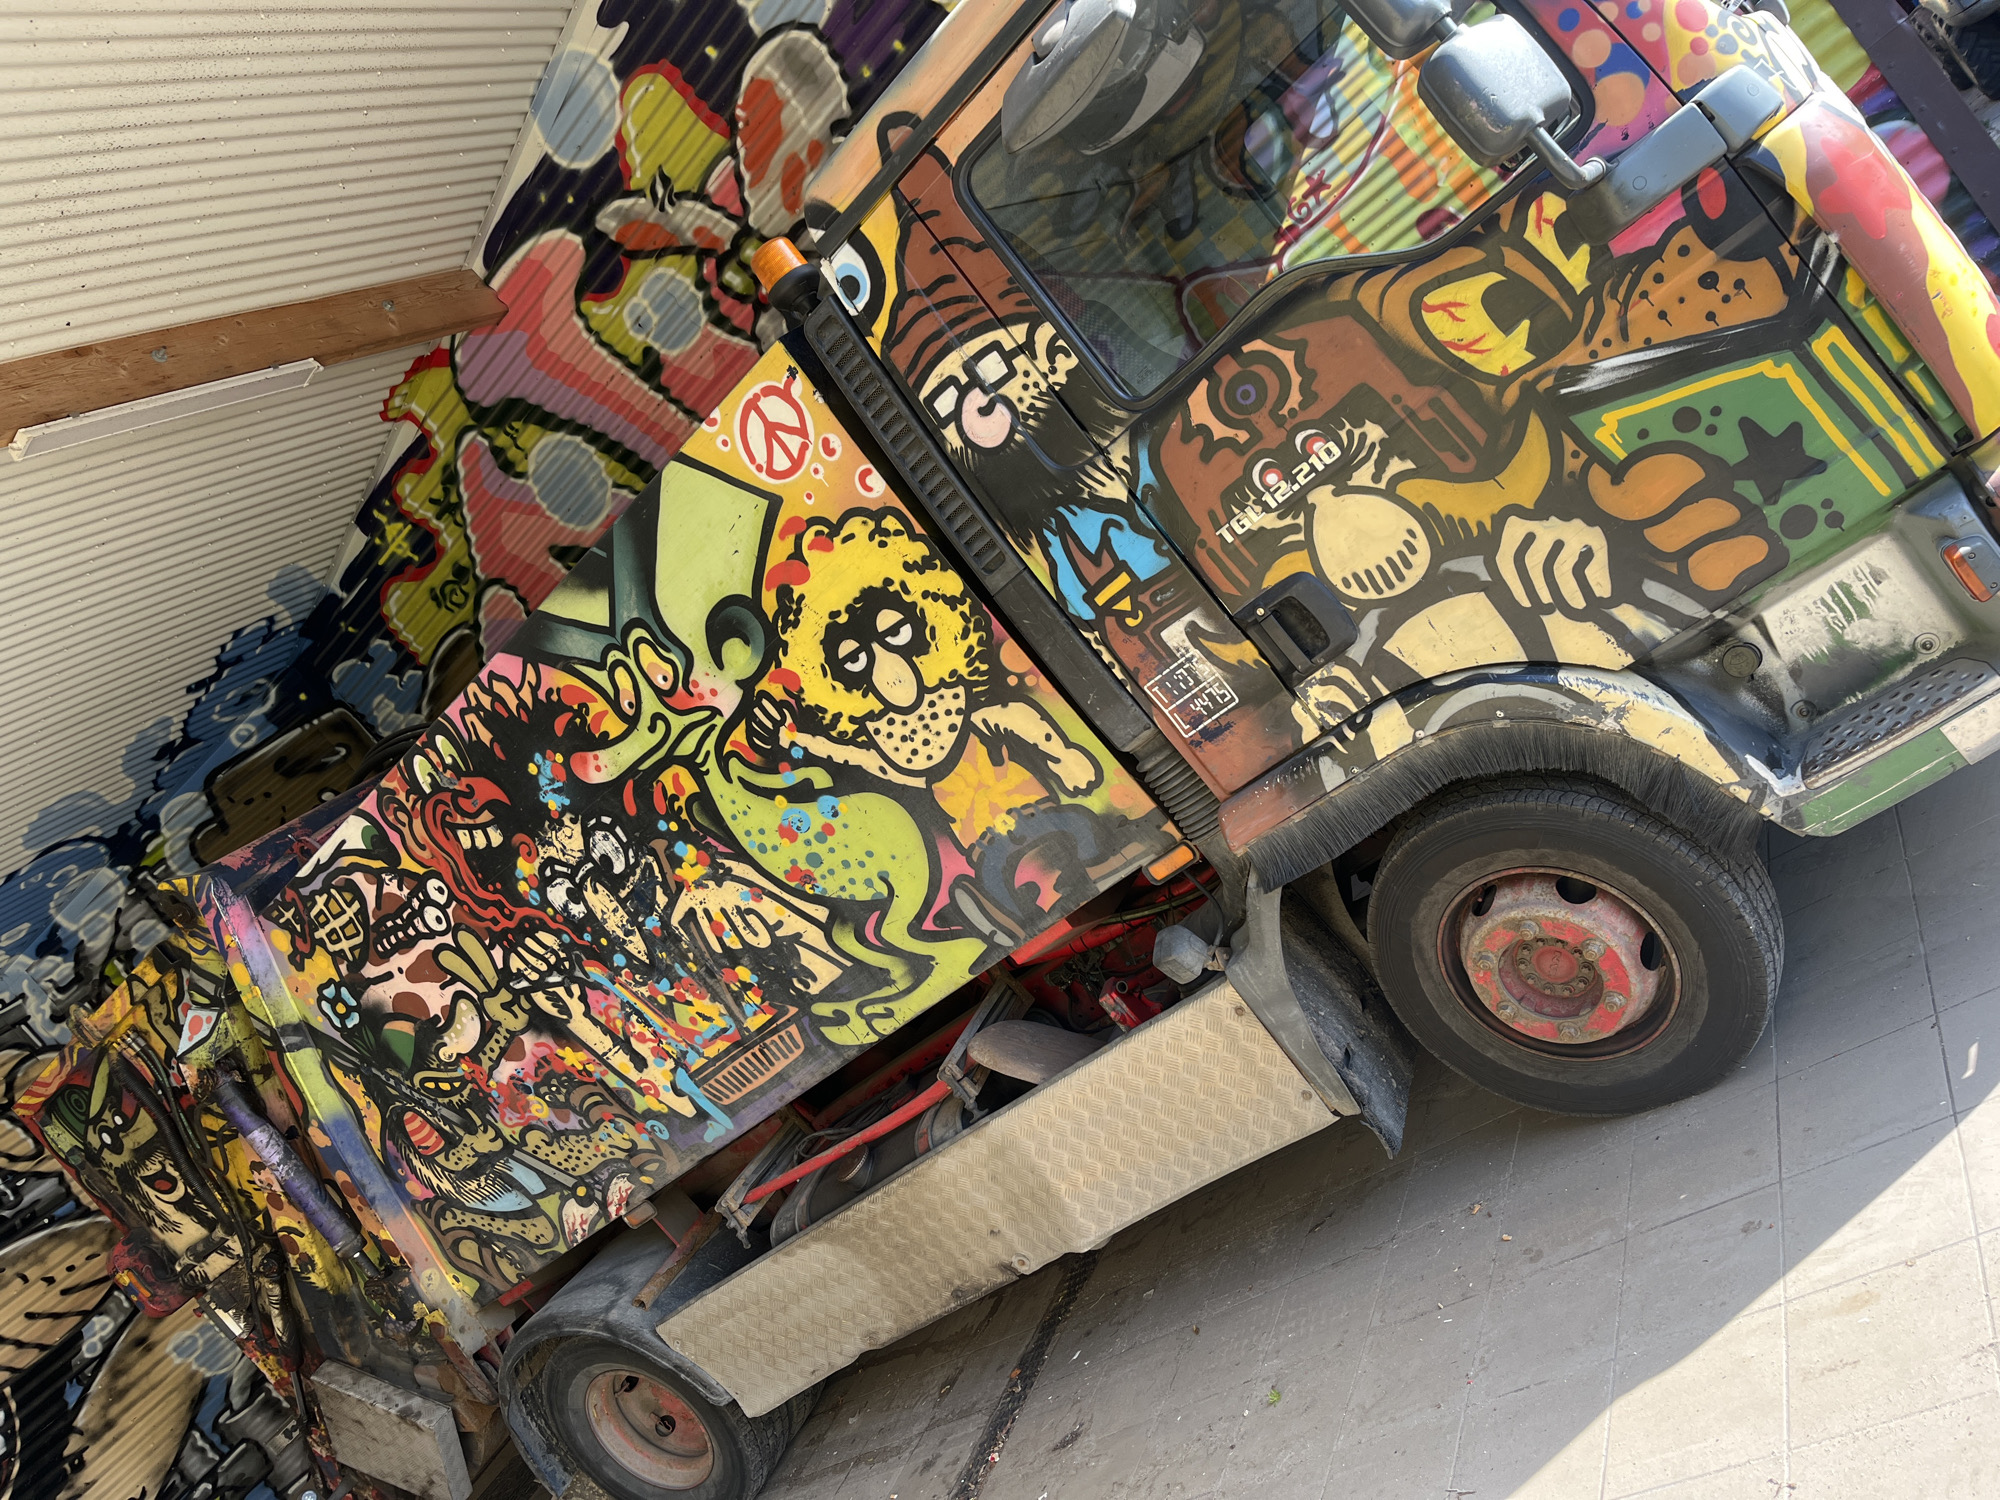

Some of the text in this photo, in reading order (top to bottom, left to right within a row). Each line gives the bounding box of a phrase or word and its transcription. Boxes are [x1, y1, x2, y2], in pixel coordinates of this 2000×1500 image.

[1215, 441, 1342, 544] TGL 12.210
[1190, 682, 1232, 715] 4475
